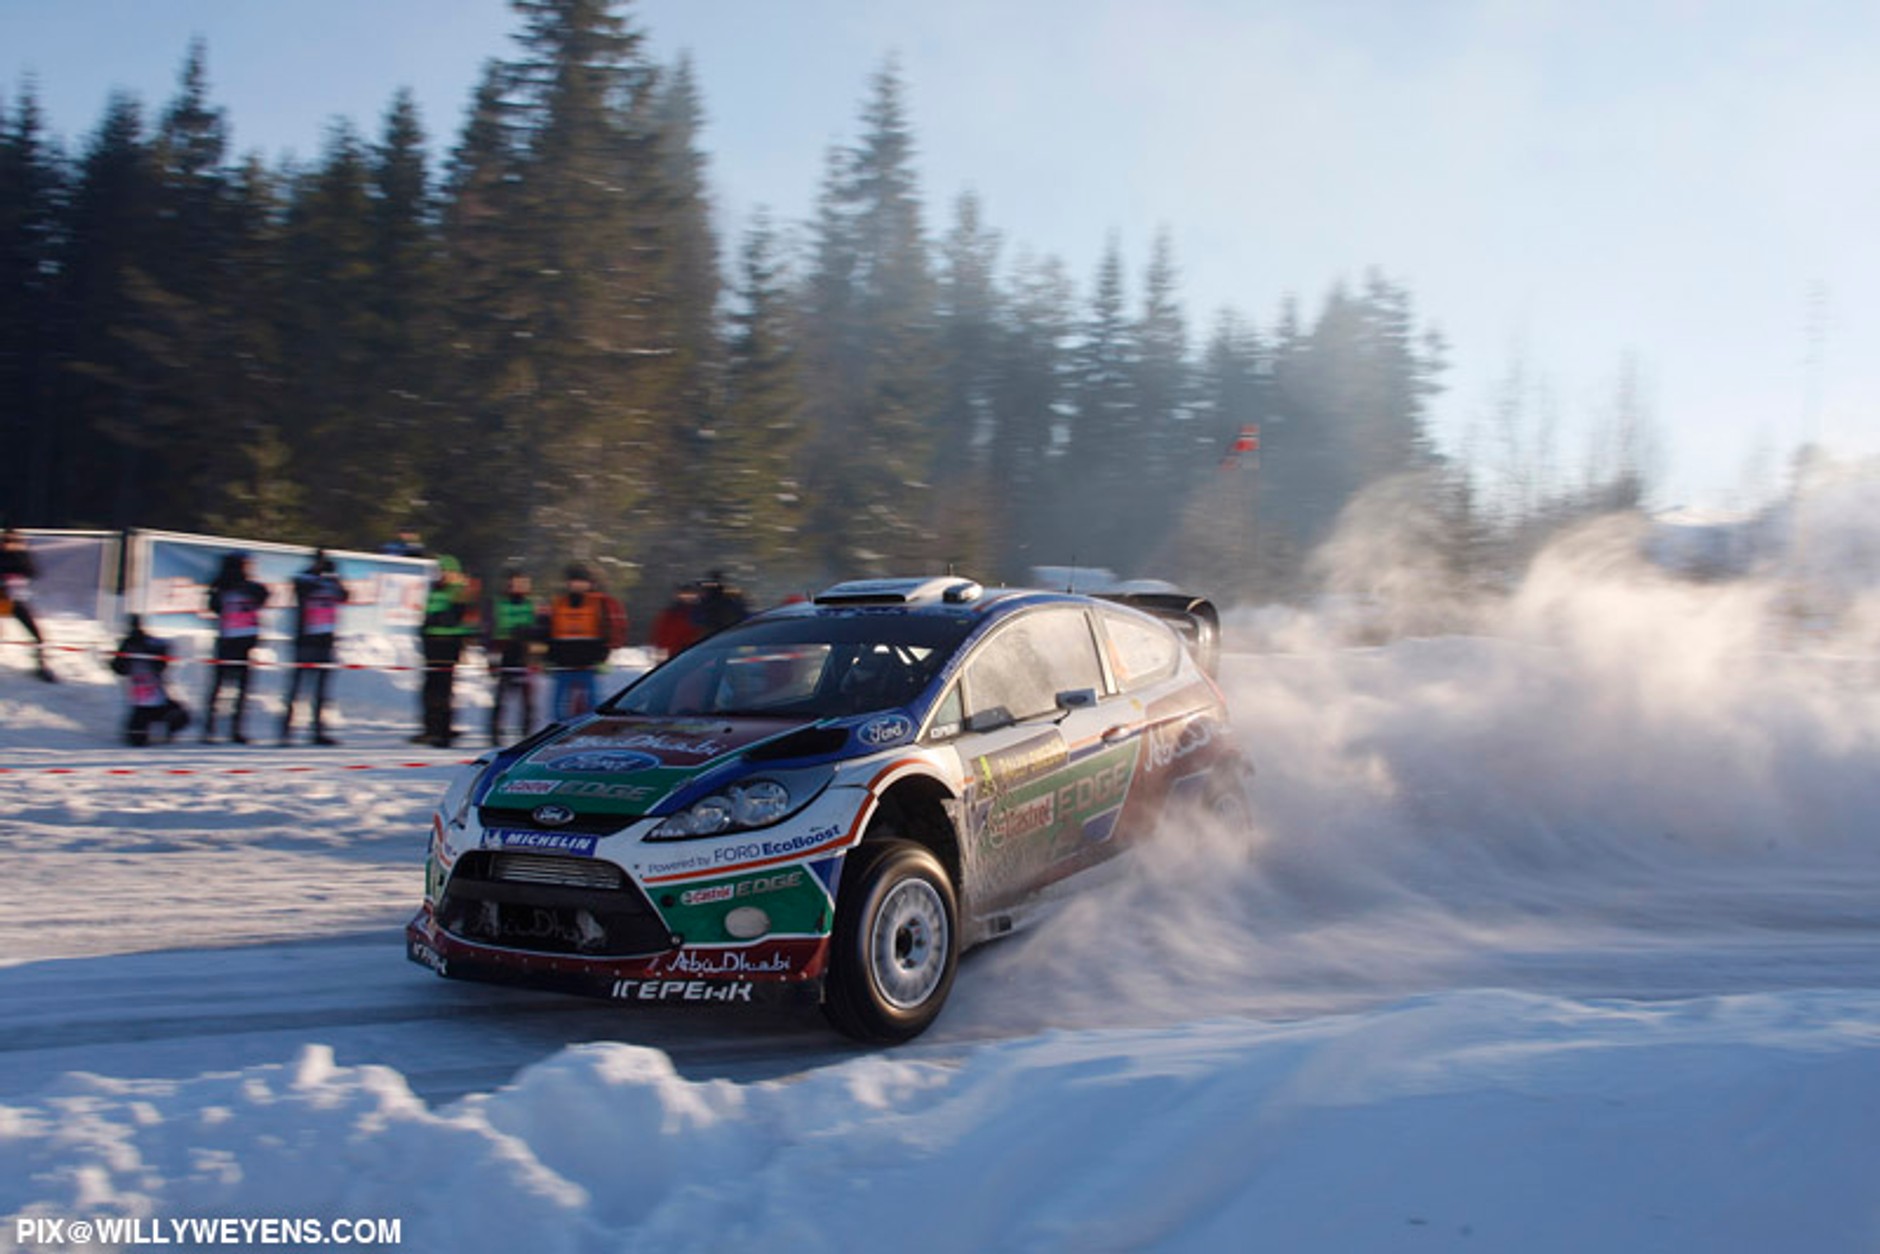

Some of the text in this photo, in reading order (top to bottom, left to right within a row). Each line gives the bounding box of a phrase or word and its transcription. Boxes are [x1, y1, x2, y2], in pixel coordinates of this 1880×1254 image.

[870, 719, 902, 743] Ford
[506, 833, 592, 849] MICHELIN
[648, 825, 841, 872] Powered by FORD EcoBoost
[736, 872, 803, 896] EDGE
[666, 950, 792, 972] Abu Dhabi
